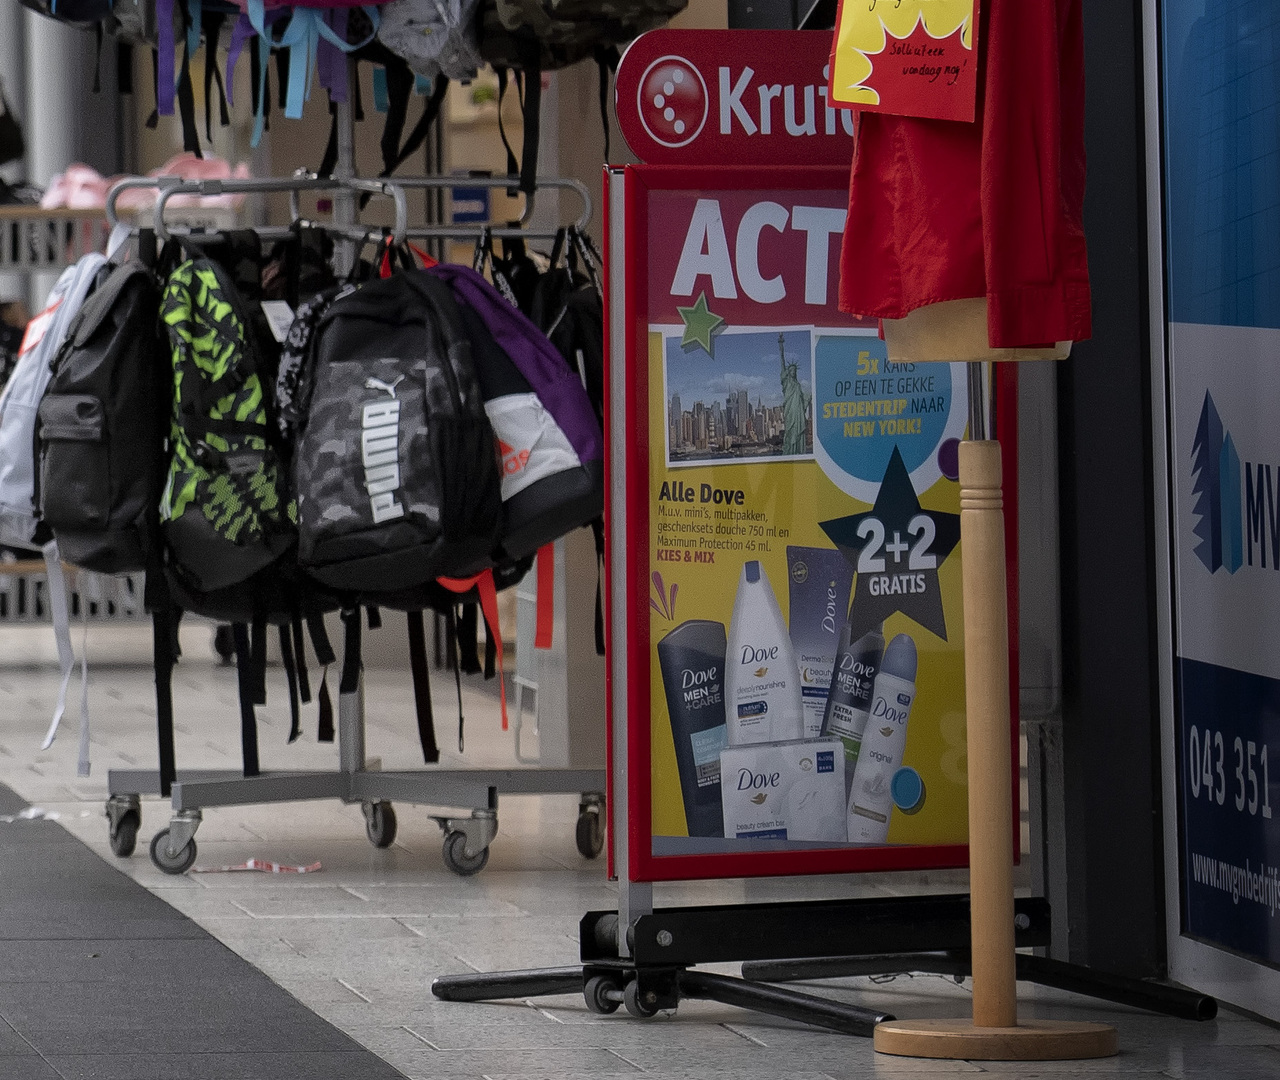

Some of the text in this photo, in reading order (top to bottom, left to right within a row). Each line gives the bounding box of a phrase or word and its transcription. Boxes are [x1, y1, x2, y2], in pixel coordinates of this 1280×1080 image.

[718, 66, 854, 137] Krui
[856, 351, 879, 376] 5x
[835, 376, 935, 397] OP EEN TE GEKKE
[823, 396, 945, 419] STEDENTRIP NAAR
[843, 418, 922, 437] NEW YORK!
[362, 400, 405, 524] PUMA
[659, 481, 745, 506] Alle Dove
[714, 509, 769, 523] multipakken,
[657, 521, 789, 538] geschenksets douche 750 ml en
[657, 535, 772, 552] Maximum Protection 45 ml.
[856, 515, 937, 573] 2+2
[657, 549, 715, 563] KIES & MIX
[869, 574, 926, 596] GRATIS
[821, 588, 837, 634] Dove
[741, 644, 779, 665] Dove
[839, 652, 875, 678] Dove
[681, 667, 717, 689] Dove
[837, 672, 861, 688] MEN
[684, 686, 709, 702] MEN
[833, 712, 852, 723] FRESH
[834, 705, 853, 717] EXTRA
[873, 696, 907, 725] Dove
[869, 750, 893, 764] original
[737, 768, 780, 791] Dove
[1190, 725, 1272, 819] 043 351
